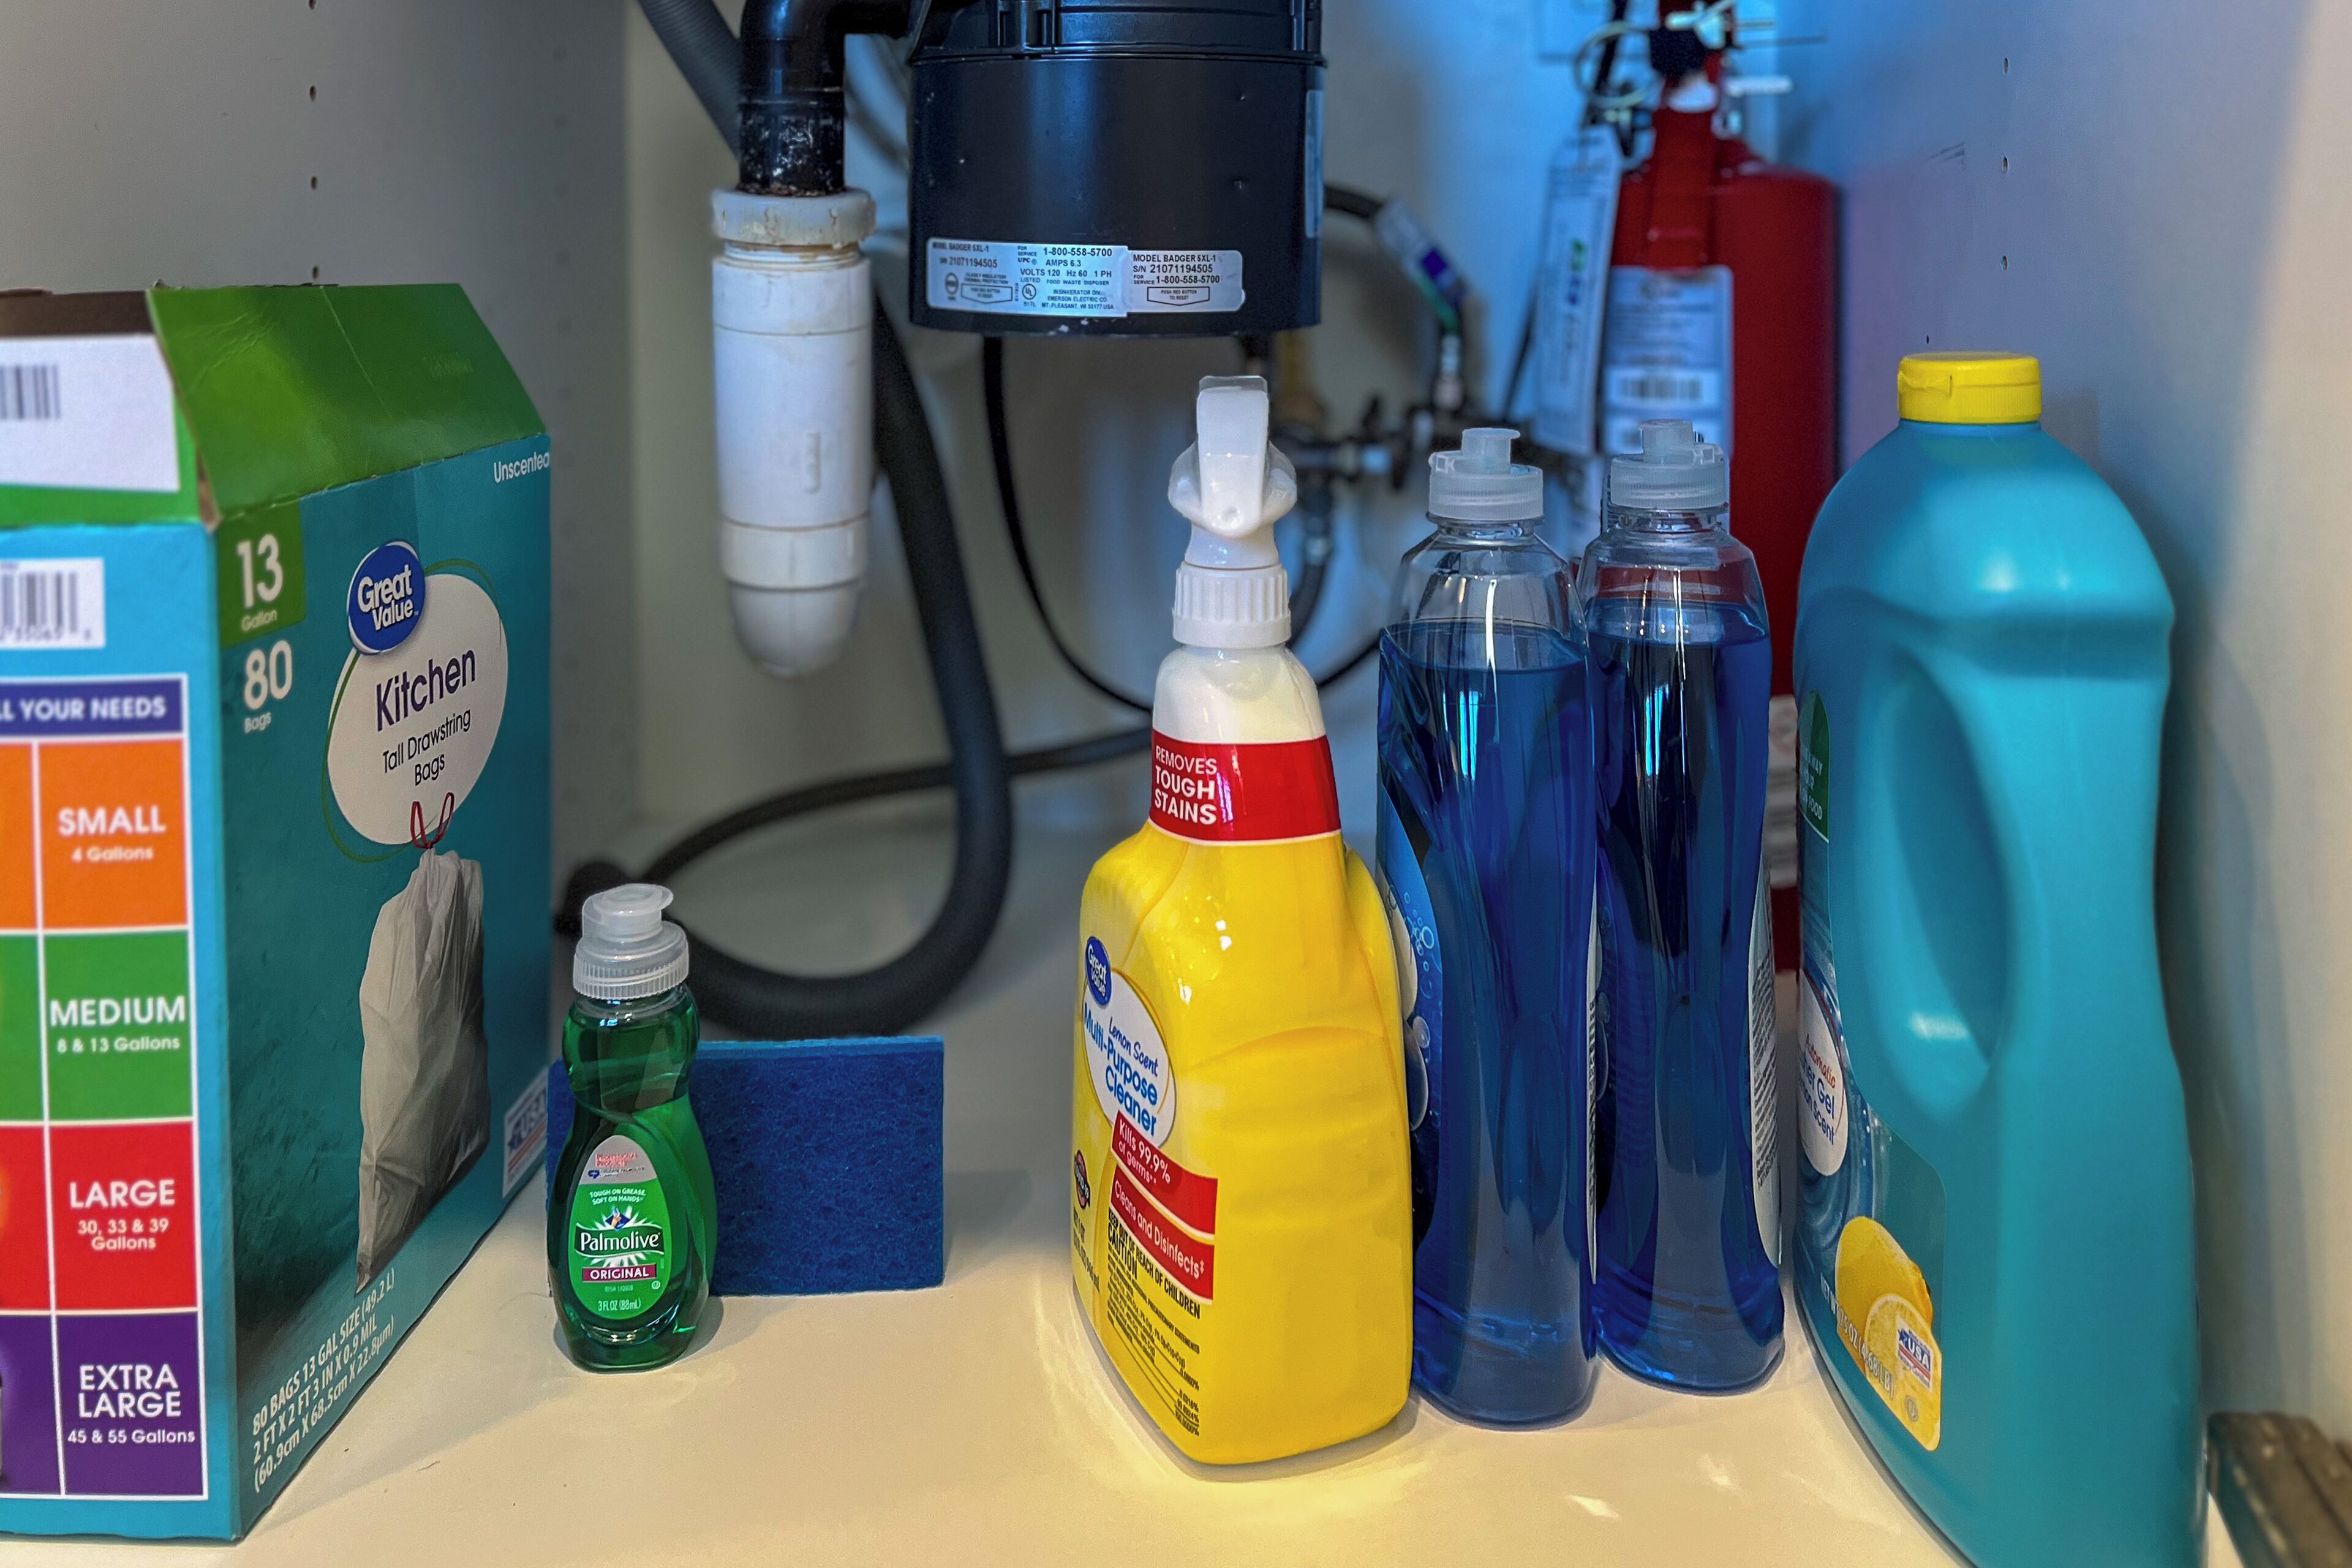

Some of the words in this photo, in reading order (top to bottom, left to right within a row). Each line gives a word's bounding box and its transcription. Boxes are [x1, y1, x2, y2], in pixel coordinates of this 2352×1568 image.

[949, 257, 997, 268] 21071194505
[1043, 247, 1112, 256] 1-800-558-5700
[1150, 264, 1213, 273] 21071194505
[1156, 275, 1220, 284] 1-800-558-5700
[236, 533, 284, 609] 13
[358, 564, 413, 612] Great
[241, 609, 277, 631] Gallon
[372, 599, 413, 630] Value
[244, 639, 293, 710] 80
[375, 649, 476, 732] Kitchen
[20, 697, 85, 722] YOUR
[91, 695, 167, 720] NEEDS
[244, 712, 271, 733] Bags
[382, 742, 404, 774] Tall
[407, 709, 471, 761] Drawstring
[415, 753, 445, 786] Bags
[1155, 745, 1218, 775] REMOVES
[1155, 765, 1215, 800] TOUGH
[58, 805, 167, 836] SMALL
[1155, 788, 1217, 826] STAINS
[72, 847, 82, 862] 4
[87, 845, 154, 862] Gallons
[1088, 944, 1107, 984] Great
[49, 995, 186, 1027] MEDIUM
[72, 1039, 84, 1053] &
[90, 1038, 109, 1053] 13
[114, 1036, 180, 1052] Gallons
[1084, 1002, 1157, 1106] Multi-Purpose
[1109, 1016, 1131, 1055] Lemon
[1133, 1041, 1159, 1077] Scent
[1106, 1065, 1156, 1136] Cleaner
[1817, 1077, 1834, 1119] Gel
[1813, 1100, 1834, 1145] Scent
[1118, 1140, 1126, 1155] of
[1120, 1119, 1136, 1151] Kills
[1139, 1140, 1170, 1184] 99.9%
[69, 1180, 175, 1208] LARGE
[589, 1188, 611, 1198] TOUGH
[592, 1197, 607, 1205] SOFT
[1115, 1180, 1136, 1221] Cleans
[1137, 1212, 1153, 1239] and
[77, 1219, 103, 1238] 30,
[107, 1219, 128, 1234] 33
[132, 1219, 145, 1234] &
[149, 1218, 169, 1234] 39
[91, 1235, 156, 1251] Gallons
[581, 1231, 660, 1251] Palmolive
[1108, 1222, 1137, 1280] CAUTION
[590, 1267, 649, 1280] ORIGINAL
[1136, 1246, 1154, 1279] REACH
[1155, 1267, 1164, 1287] OF
[1164, 1277, 1200, 1319] CHILDREN
[598, 1300, 603, 1311] 3
[603, 1300, 609, 1311] FL
[610, 1300, 618, 1311] OZ
[619, 1297, 641, 1311] (88mL)
[253, 1405, 268, 1436] 80
[270, 1370, 301, 1419] BAGS
[303, 1355, 316, 1383] 13
[318, 1332, 338, 1366] GAL
[340, 1306, 360, 1344] SIZE
[361, 1280, 385, 1322] (49.2
[386, 1267, 395, 1292] L)
[1849, 1322, 1858, 1350] OZ
[1879, 1364, 1895, 1401] LB)
[1908, 1336, 1929, 1370] USA
[78, 1363, 178, 1391] EXTRA
[254, 1441, 262, 1465] 2
[263, 1420, 277, 1453] FT
[279, 1411, 287, 1437] X
[288, 1403, 296, 1428] 2
[298, 1385, 311, 1416] FT
[313, 1378, 320, 1400] 3
[322, 1360, 334, 1390] IN
[335, 1351, 342, 1376] X
[343, 1334, 359, 1365] 0.9
[360, 1313, 377, 1346] MIL
[78, 1392, 181, 1419] LARGE
[67, 1430, 87, 1444] 45
[91, 1430, 104, 1444] &
[108, 1430, 128, 1444] 55
[132, 1429, 195, 1444] Gallons
[254, 1428, 300, 1493] (60.9cm
[301, 1412, 309, 1438] X
[311, 1374, 348, 1428] 68.5cm
[349, 1359, 356, 1384] X
